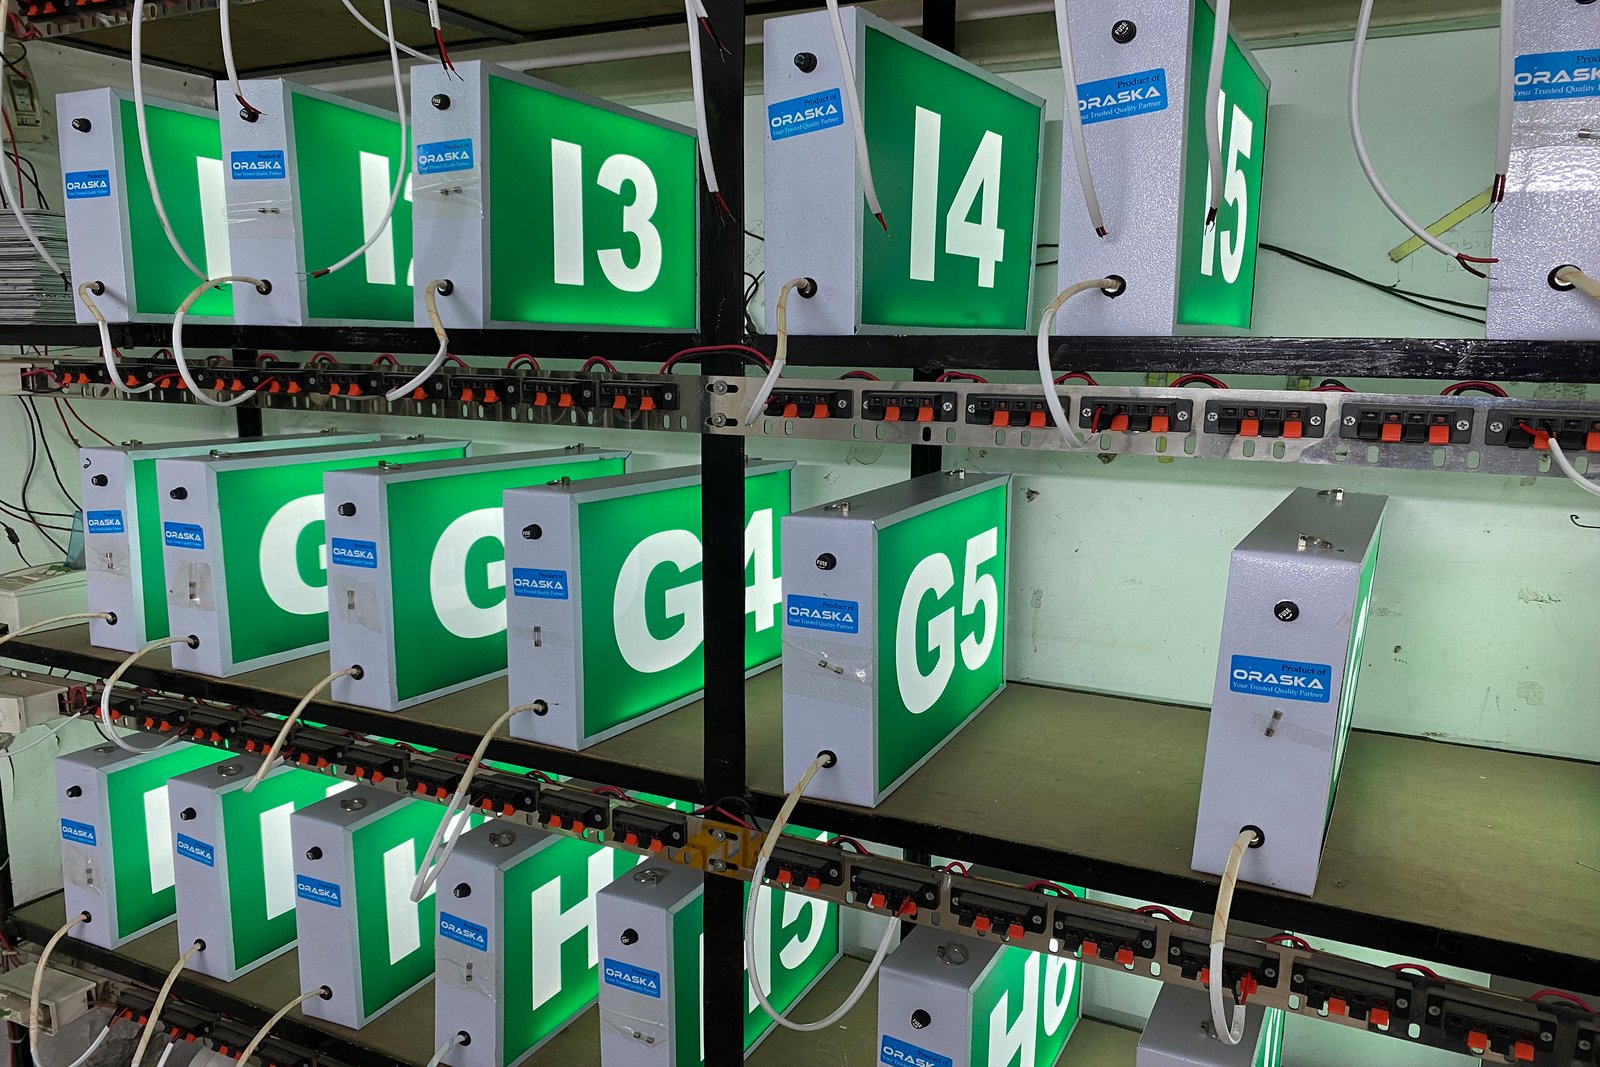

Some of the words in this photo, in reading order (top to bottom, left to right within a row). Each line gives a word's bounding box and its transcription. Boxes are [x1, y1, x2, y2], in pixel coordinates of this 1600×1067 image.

[1115, 22, 1128, 36] FUSE
[1117, 77, 1149, 88] Product
[1514, 67, 1600, 86] ORASK
[1534, 87, 1563, 95] Trusted
[1566, 84, 1595, 93] Quality
[803, 95, 829, 106] Product
[1078, 86, 1161, 111] ORASKA
[772, 105, 837, 127] ORASKA
[1090, 109, 1113, 118] Trusted
[1114, 105, 1137, 114] Quality
[1139, 101, 1161, 109] Partner
[419, 151, 469, 164] ORASKA
[233, 161, 281, 170] ORASKA
[67, 181, 107, 190] ORASKA
[196, 156, 233, 283] I
[359, 150, 413, 286] I
[166, 531, 200, 540] ORASKA
[259, 494, 329, 615] G
[334, 548, 373, 558] ORASKA
[816, 559, 828, 567] FUSE
[430, 507, 507, 639] G
[514, 579, 562, 589] ORASKA
[613, 508, 783, 673] G4
[822, 602, 846, 610] Product
[1279, 607, 1292, 619] FUSE
[789, 607, 853, 622] ORASKA
[896, 526, 998, 714] G5
[1281, 665, 1315, 675] Product
[1234, 670, 1323, 689] ORASKA
[1300, 690, 1322, 698] Partner
[298, 884, 337, 899] ORASKA
[442, 922, 483, 942] ORASKA
[532, 846, 650, 1011] H
[606, 969, 656, 988] ORASKA
[911, 1018, 923, 1029] FUSE
[883, 1046, 935, 1067] ORASK
